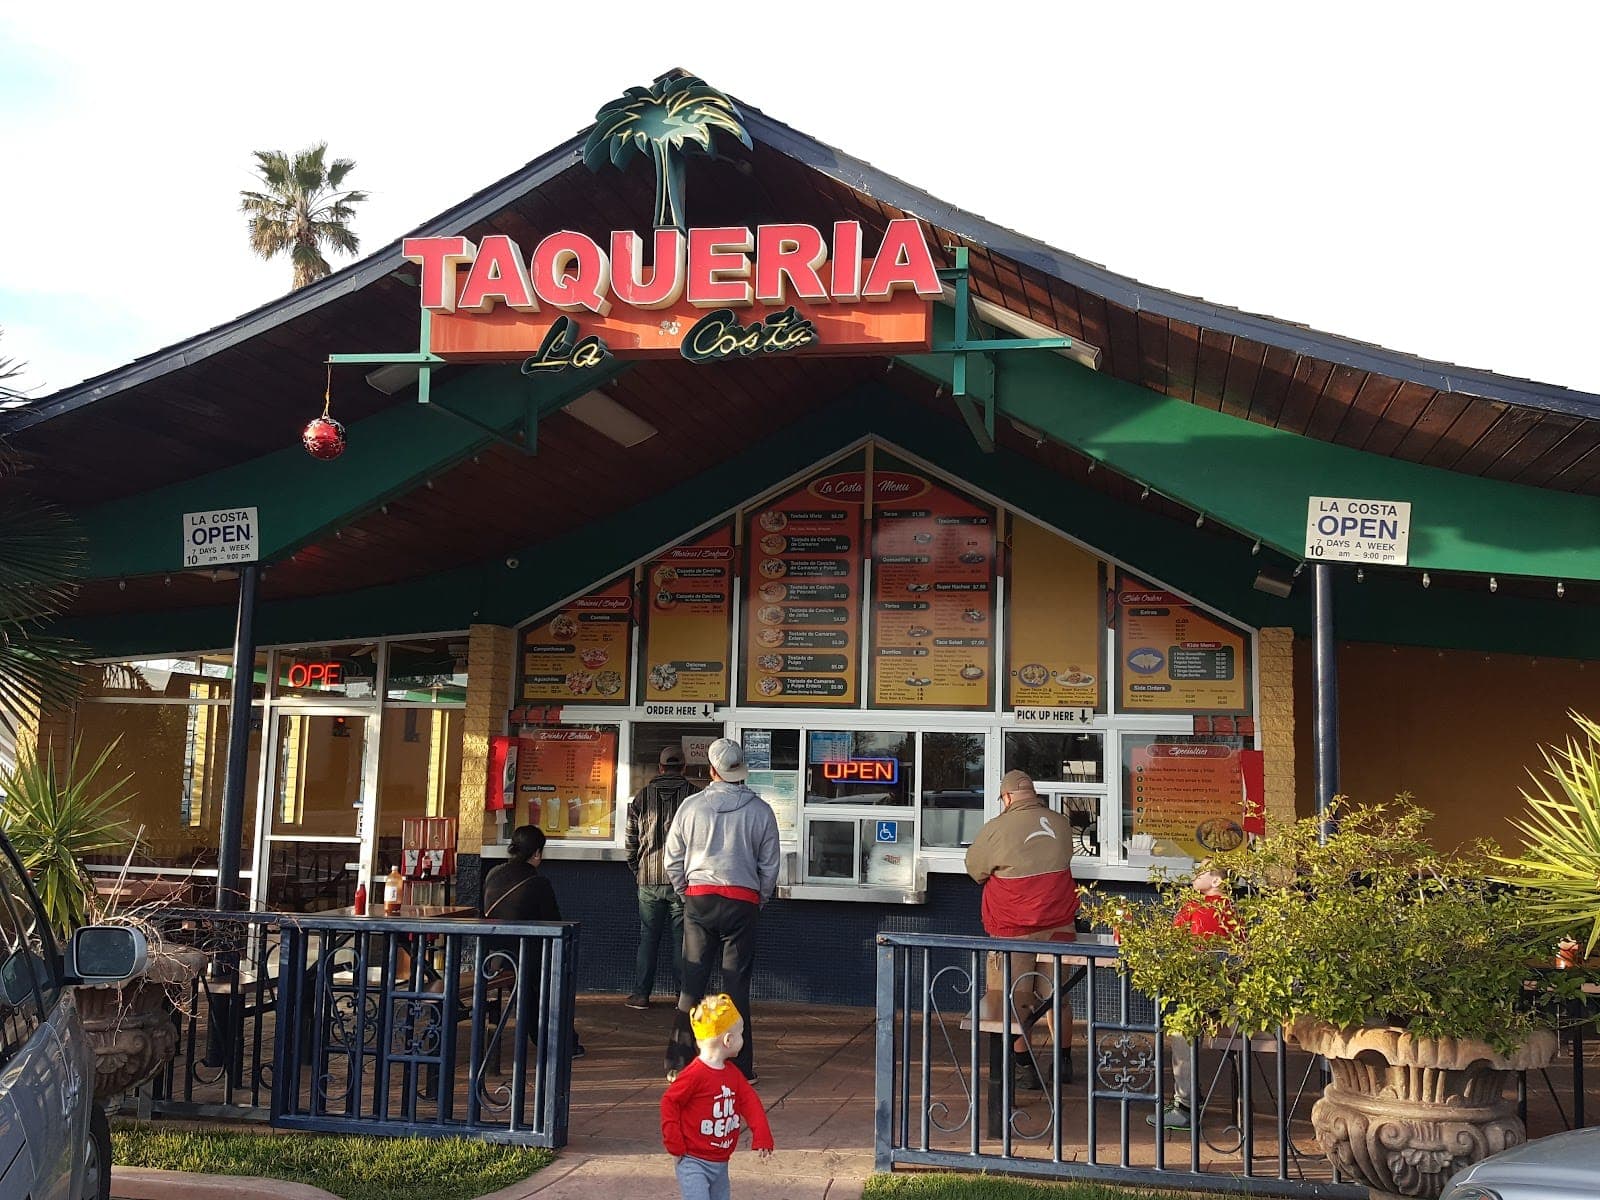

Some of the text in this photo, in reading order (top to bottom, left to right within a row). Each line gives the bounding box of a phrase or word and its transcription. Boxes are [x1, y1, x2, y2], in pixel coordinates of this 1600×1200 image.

[402, 217, 943, 314] TAQUERIA
[520, 305, 819, 376] La Costa
[820, 481, 910, 493] La Costa Menu
[1320, 501, 1397, 516] LA COSTA
[191, 511, 249, 526] LA COSTA
[192, 524, 250, 546] OPEN
[1318, 515, 1398, 540] OPEN
[199, 547, 217, 555] DAYS
[229, 544, 250, 552] WEEK
[1309, 545, 1324, 557] 10
[1326, 540, 1351, 548] DAYS
[1355, 541, 1362, 549] A
[1367, 542, 1396, 551] WEEK
[187, 555, 198, 565] 10
[646, 706, 697, 716] ORDER HERE
[1017, 710, 1074, 721] PICK UP HERE
[823, 761, 894, 781] OPEN
[701, 1113, 741, 1138] BEAR
